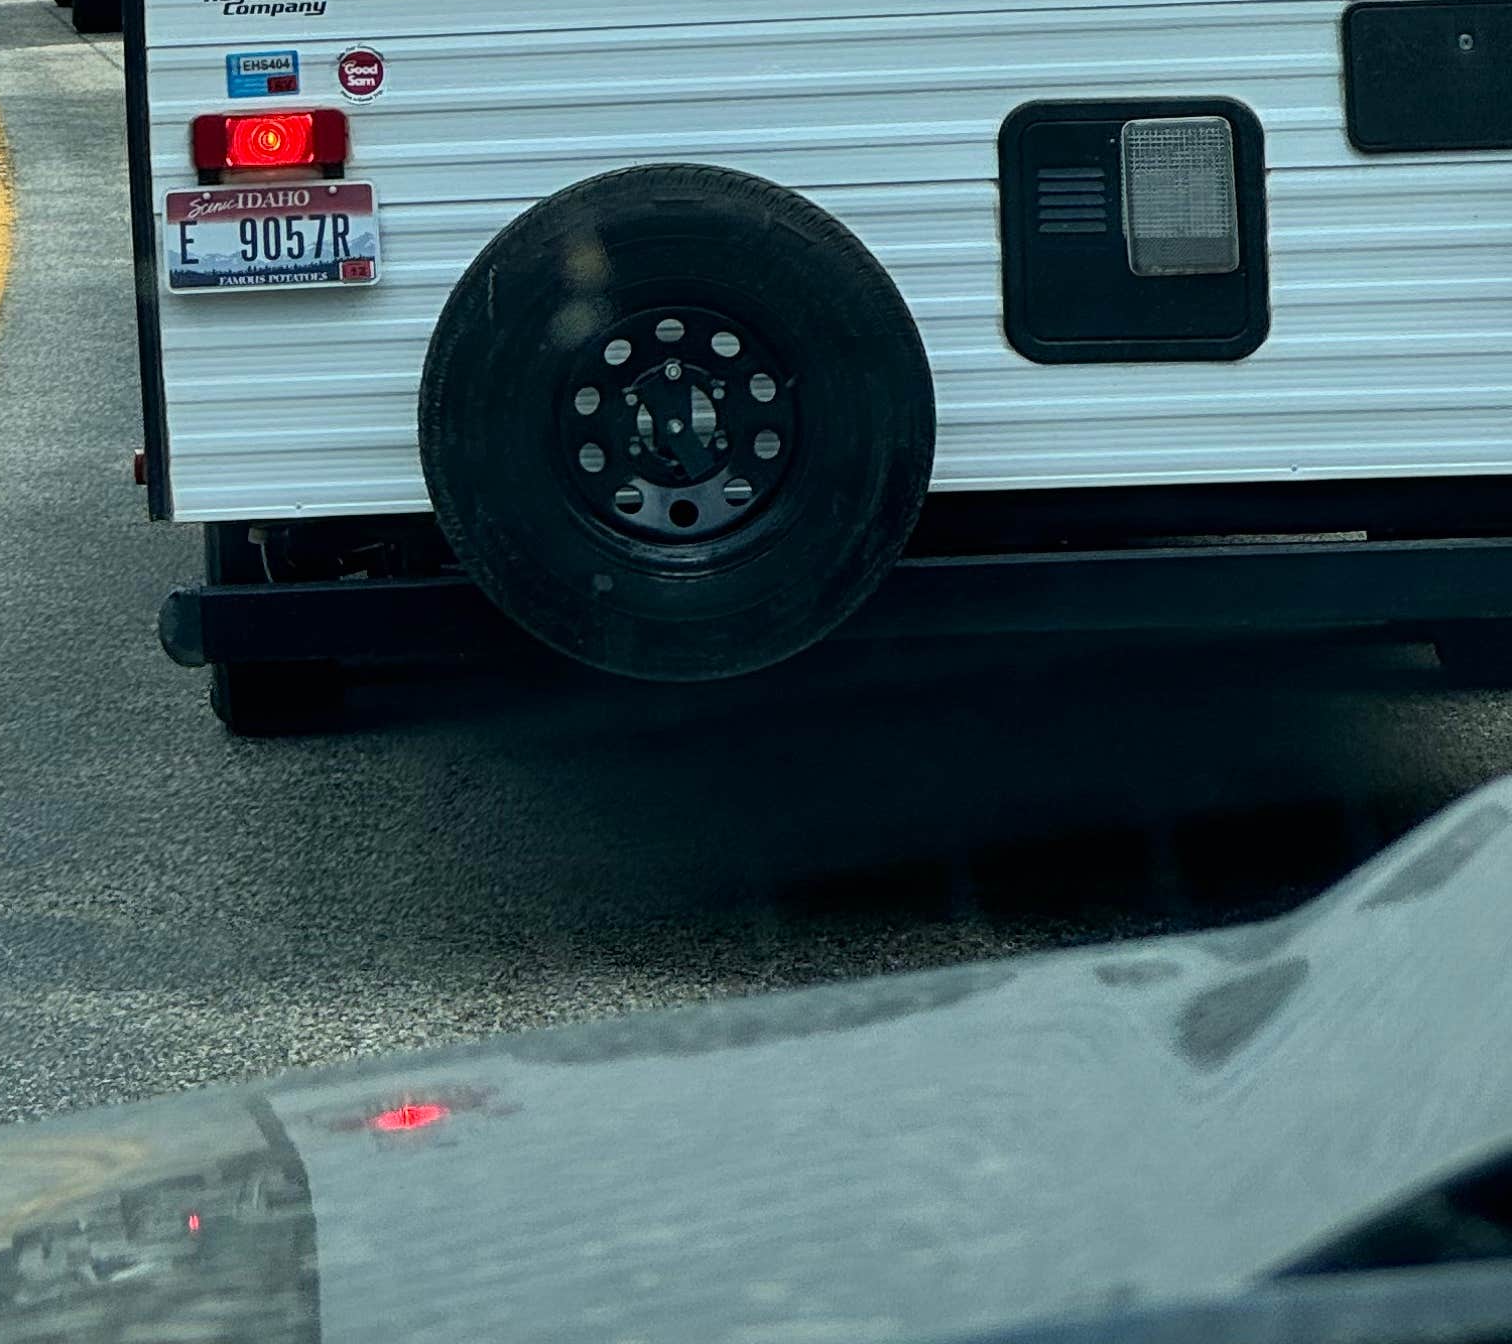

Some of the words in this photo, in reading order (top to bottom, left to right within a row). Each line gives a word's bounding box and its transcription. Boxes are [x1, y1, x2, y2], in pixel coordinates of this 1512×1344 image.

[223, 1, 327, 16] Company
[243, 58, 290, 72] EHS404
[342, 61, 378, 75] Good
[347, 75, 376, 87] Sam
[237, 190, 310, 209] IDAHO
[180, 220, 199, 264] E
[240, 213, 351, 261] 9057R
[219, 276, 266, 286] FAMOUS
[269, 271, 328, 282] POTATOES
